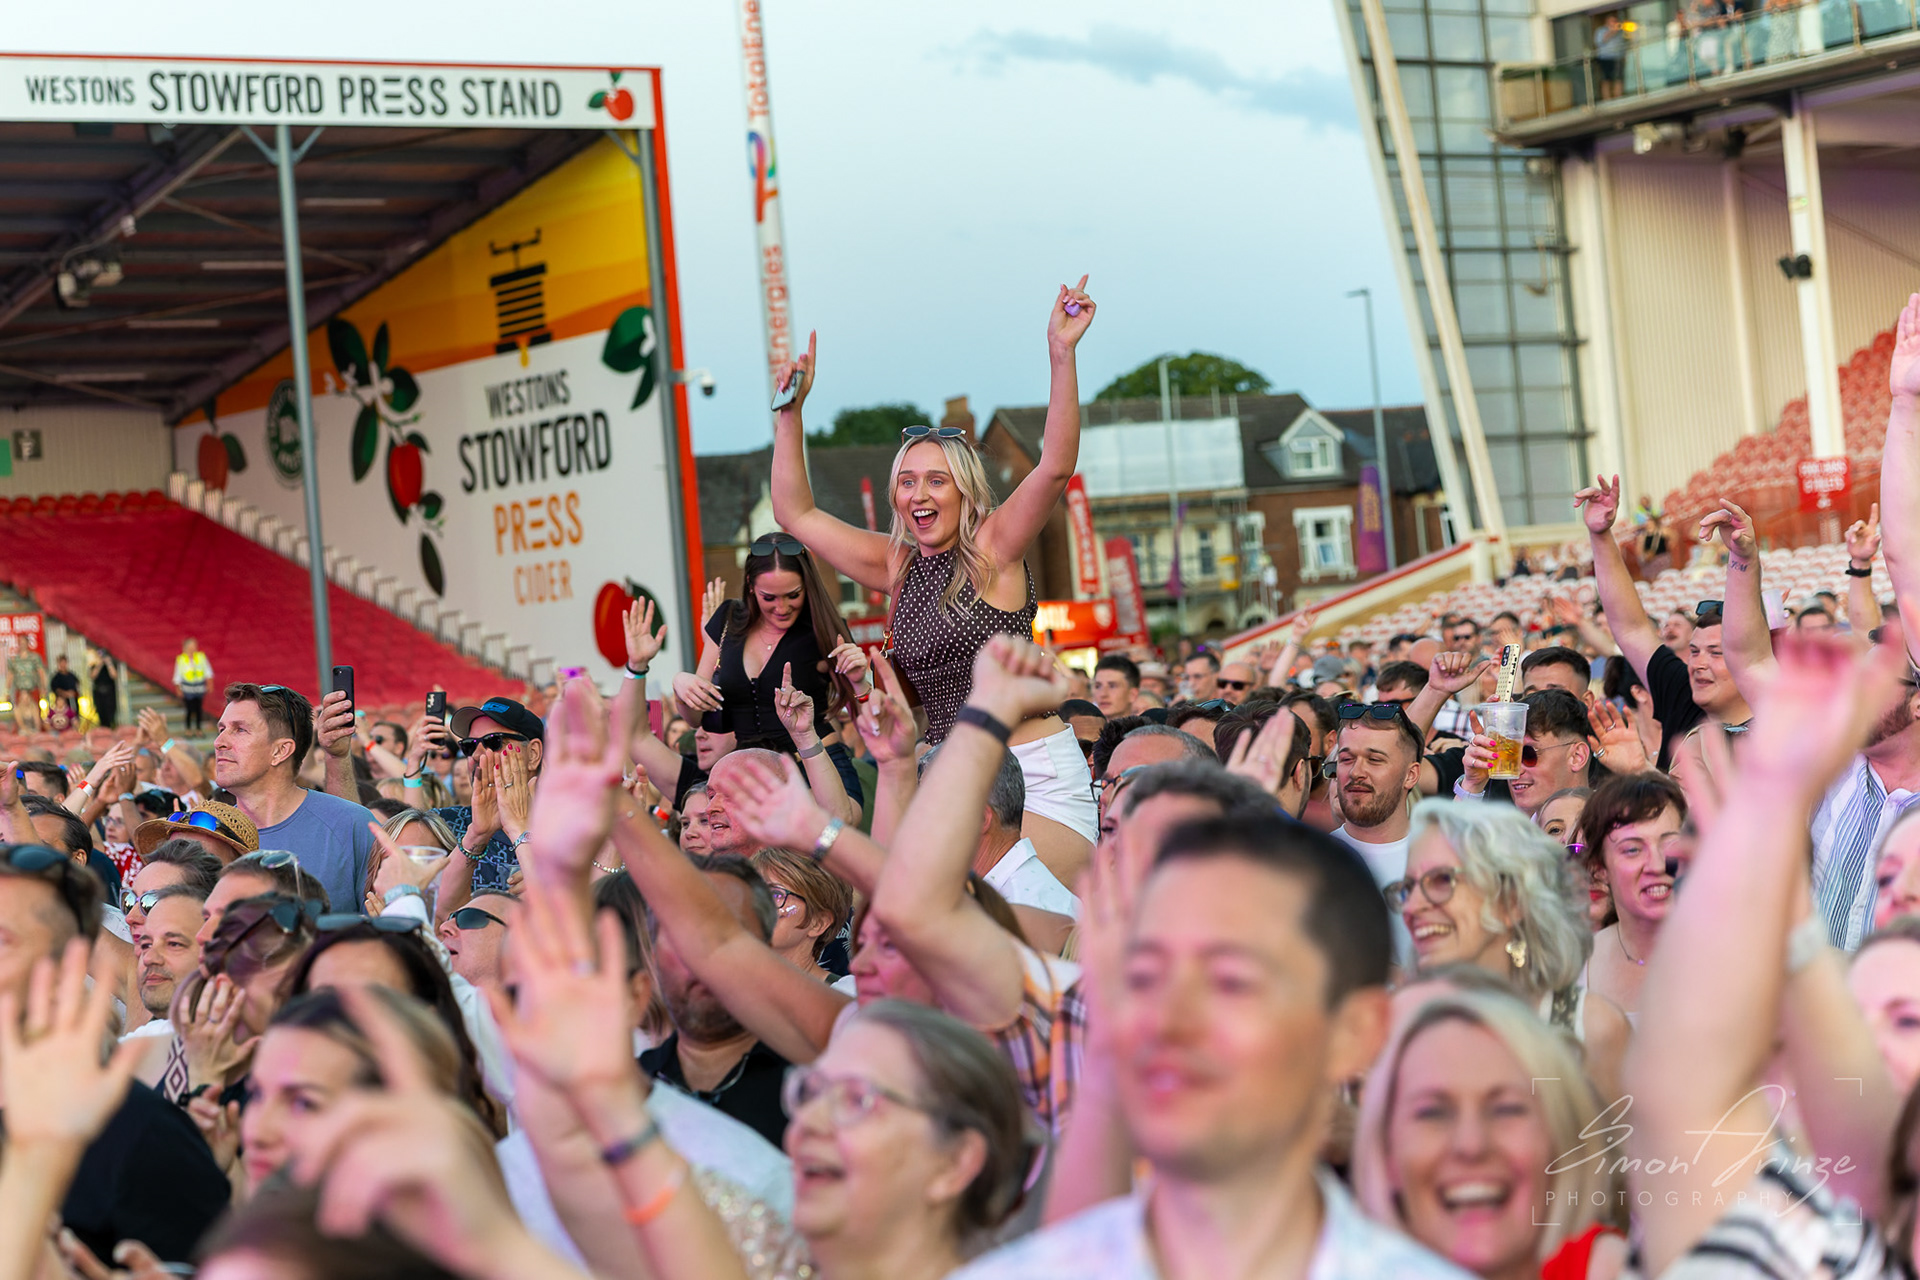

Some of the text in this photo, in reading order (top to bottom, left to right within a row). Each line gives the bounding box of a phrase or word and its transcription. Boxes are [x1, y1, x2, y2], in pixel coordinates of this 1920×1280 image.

[25, 71, 562, 118] WESTONS STOWFORD PRESS STAND
[485, 370, 571, 419] WESTONS
[458, 409, 611, 494] STOWFORD
[493, 490, 583, 557] PRESS
[513, 559, 574, 606] CIDER
